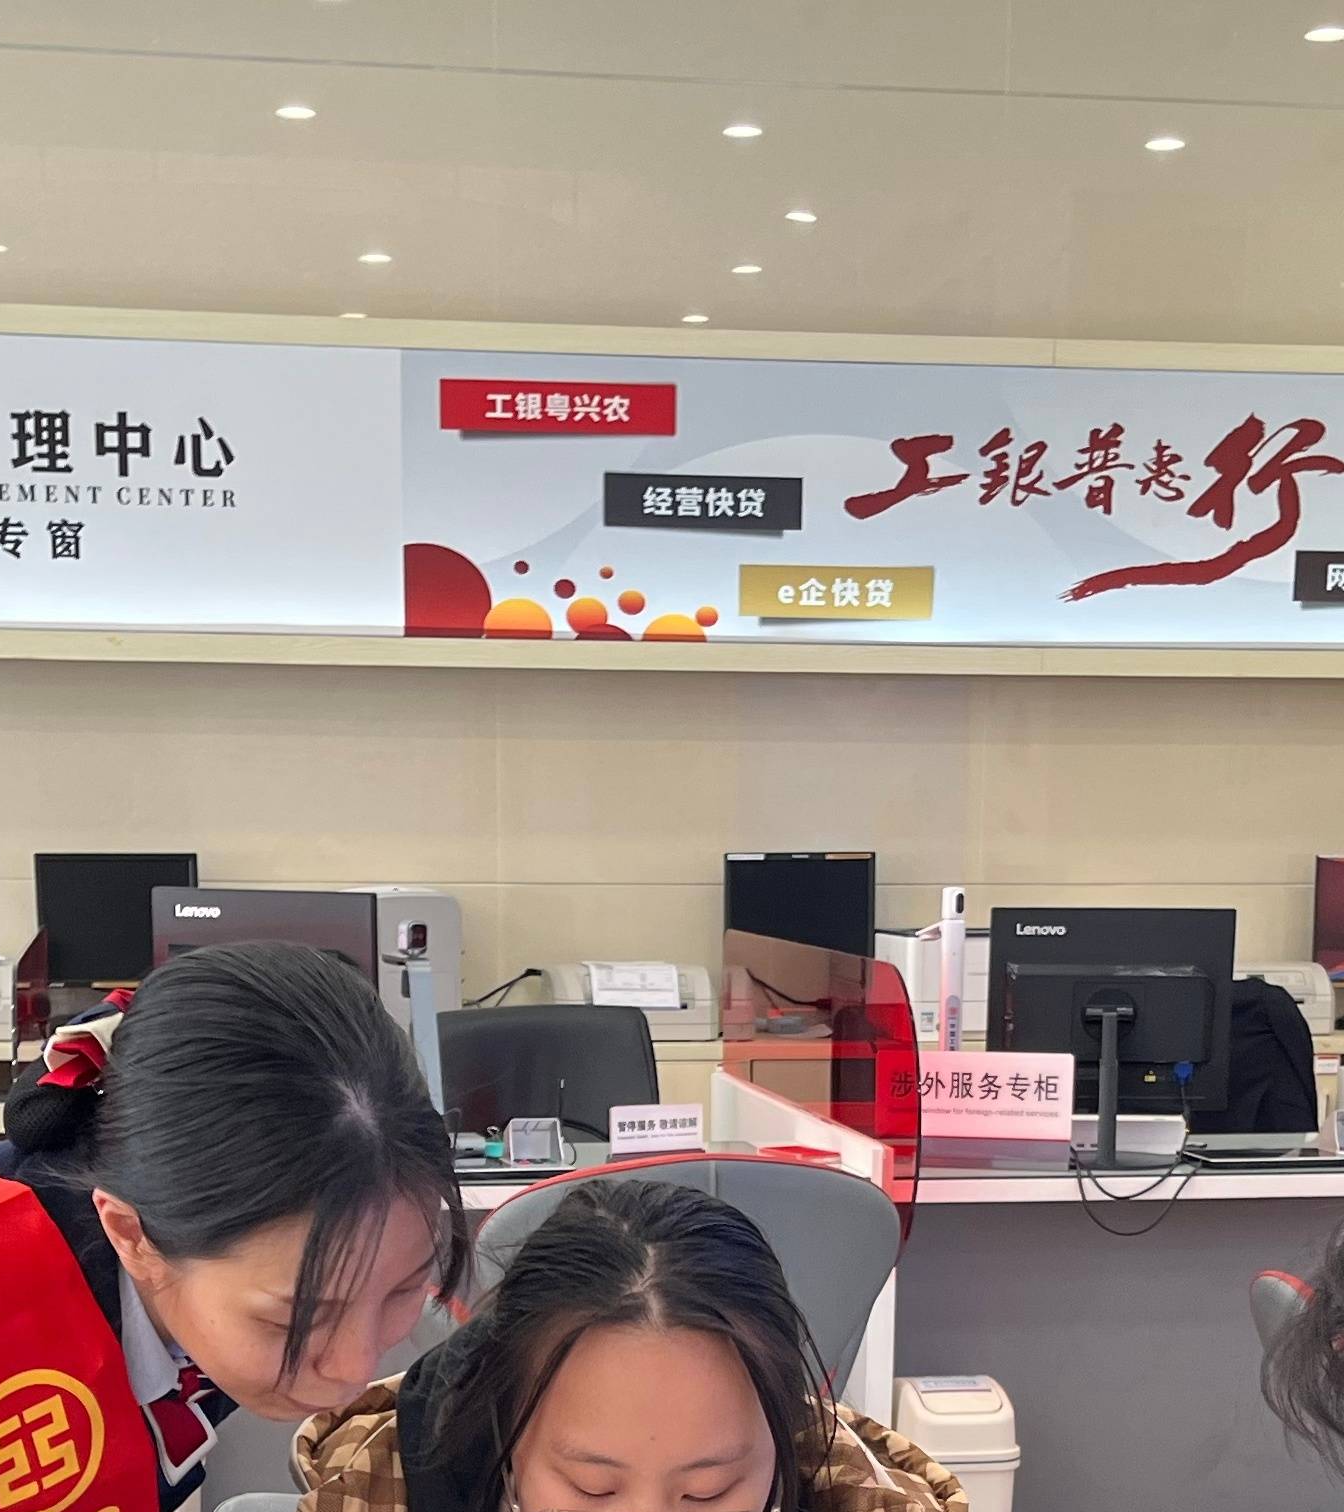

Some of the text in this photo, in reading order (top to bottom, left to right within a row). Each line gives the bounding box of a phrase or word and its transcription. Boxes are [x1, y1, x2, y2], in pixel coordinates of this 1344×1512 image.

[484, 392, 631, 424] 工银粤兴农
[117, 487, 237, 509] CENTER
[642, 486, 767, 519] 经营快贷
[777, 577, 893, 608] e企快贷
[175, 903, 221, 919] Lenovo
[1015, 921, 1067, 937] Lenovo
[890, 1072, 1060, 1102] 涉外服务专柜
